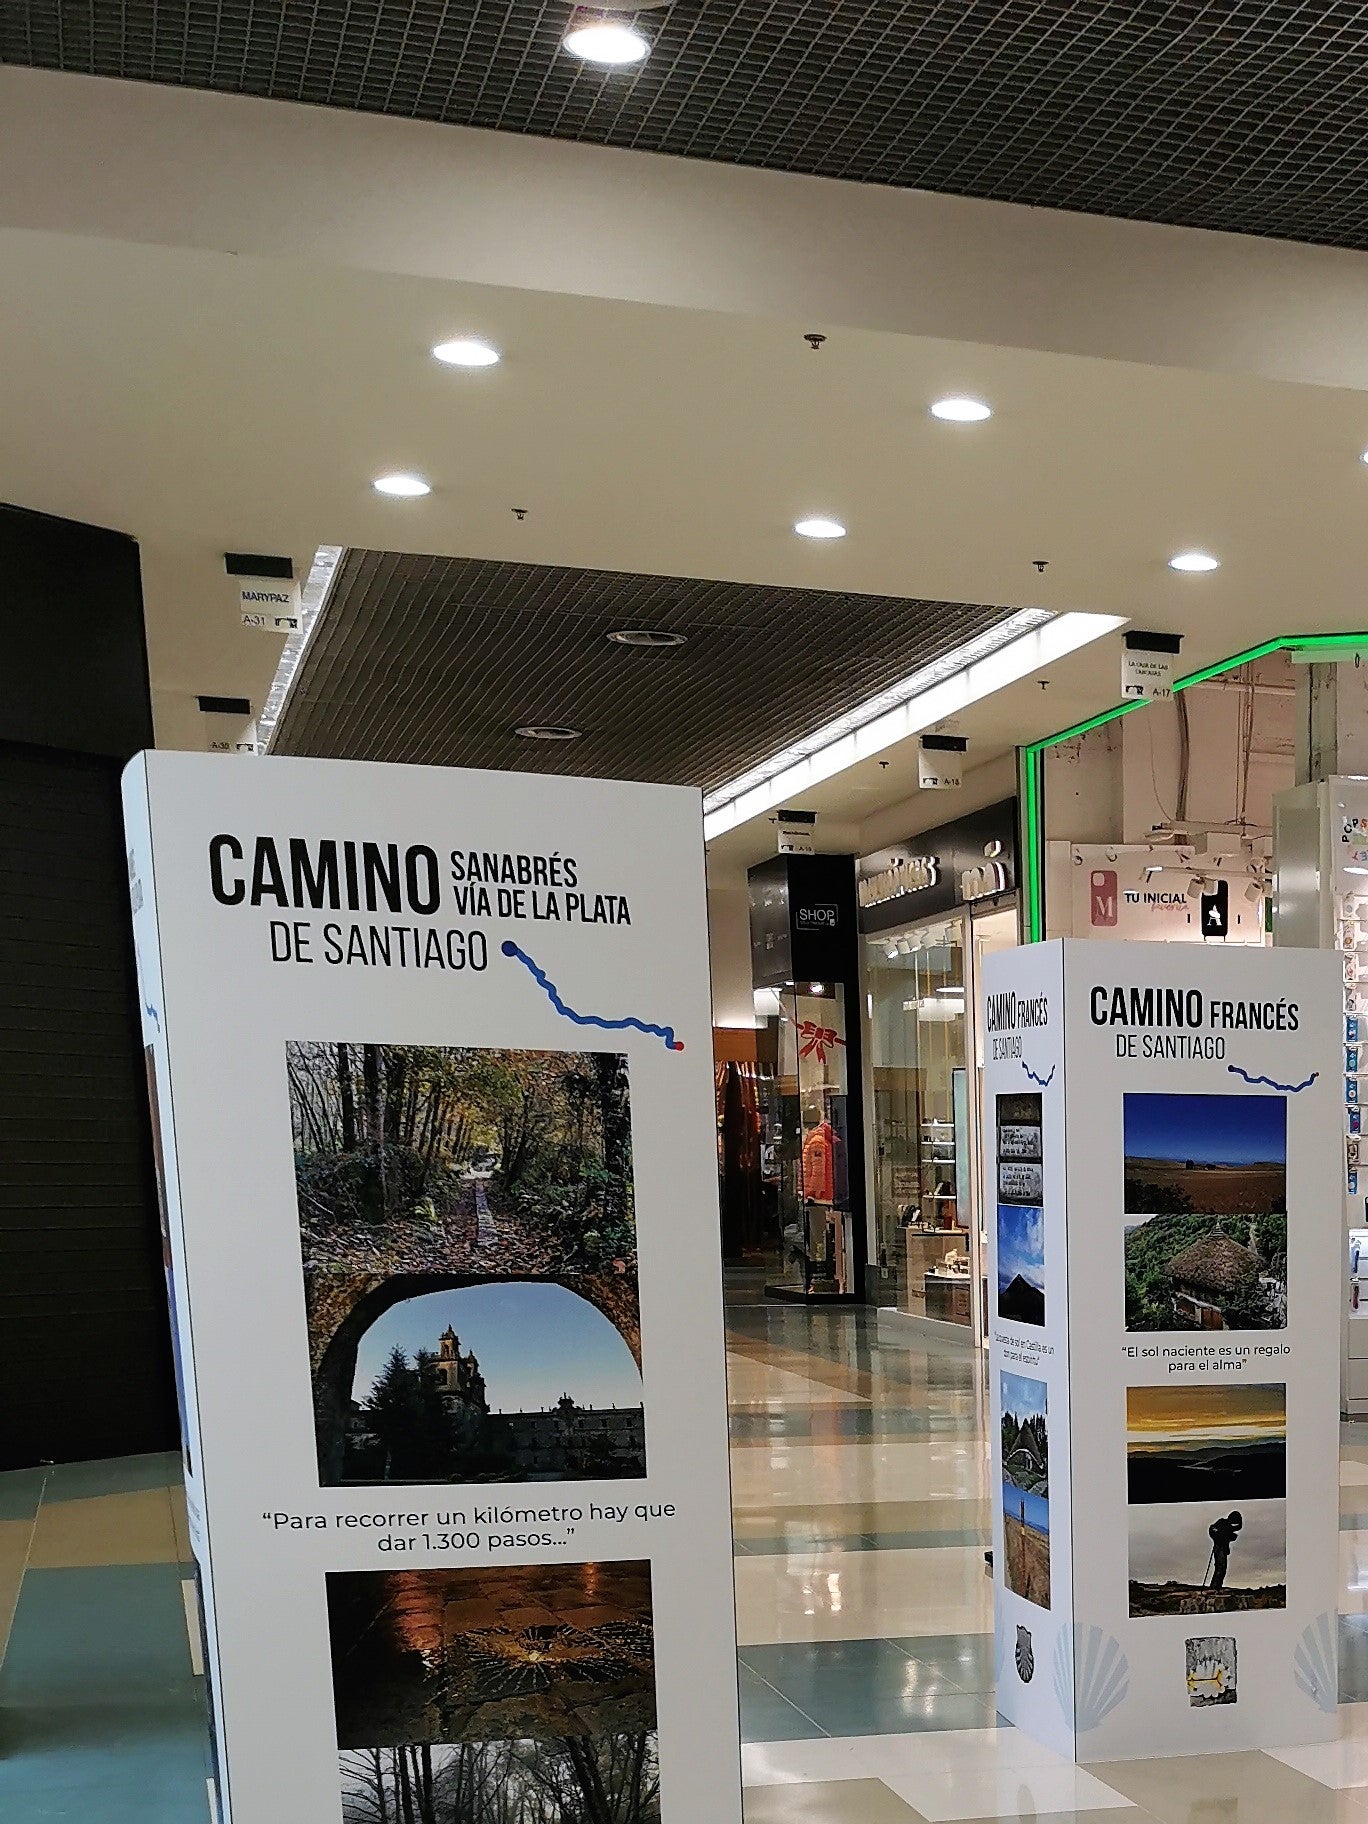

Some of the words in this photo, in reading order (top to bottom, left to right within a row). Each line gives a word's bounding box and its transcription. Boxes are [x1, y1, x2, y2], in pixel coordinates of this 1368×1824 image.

[241, 591, 290, 603] MARYPAZ
[1152, 688, 1171, 698] A-17
[209, 833, 441, 915] CAMINO
[450, 851, 578, 888] SANABRÉS
[453, 882, 492, 917] VÍA
[499, 890, 527, 918] DE
[533, 892, 561, 921] LA
[566, 894, 631, 925] PLATA
[1124, 892, 1140, 903] TU
[1144, 892, 1187, 904] INICIAL
[799, 908, 835, 921] SHOP
[270, 921, 313, 963] DE
[323, 923, 488, 971] SANTIAGO
[987, 991, 1016, 1032] CAMINO
[1017, 992, 1048, 1028] FRANCÉS
[1090, 986, 1202, 1028] CAMINO
[1210, 998, 1299, 1031] FRANCÉS
[1116, 1034, 1137, 1058] DE
[1142, 1034, 1226, 1060] SANTIAGO
[1122, 1346, 1140, 1358] “El
[1141, 1344, 1160, 1358] sol
[1163, 1344, 1216, 1357] naciente
[1218, 1345, 1232, 1356] es
[1235, 1345, 1251, 1356] un
[1253, 1344, 1291, 1359] regalo
[1168, 1361, 1196, 1374] para
[1199, 1359, 1210, 1371] el
[262, 1512, 327, 1530] “Para
[335, 1512, 428, 1529] recorrer
[436, 1510, 466, 1525] un
[474, 1505, 583, 1525] kilómetro
[589, 1502, 627, 1522] hay
[634, 1502, 676, 1520] que
[377, 1532, 415, 1552] dar
[423, 1531, 480, 1551] 1.300
